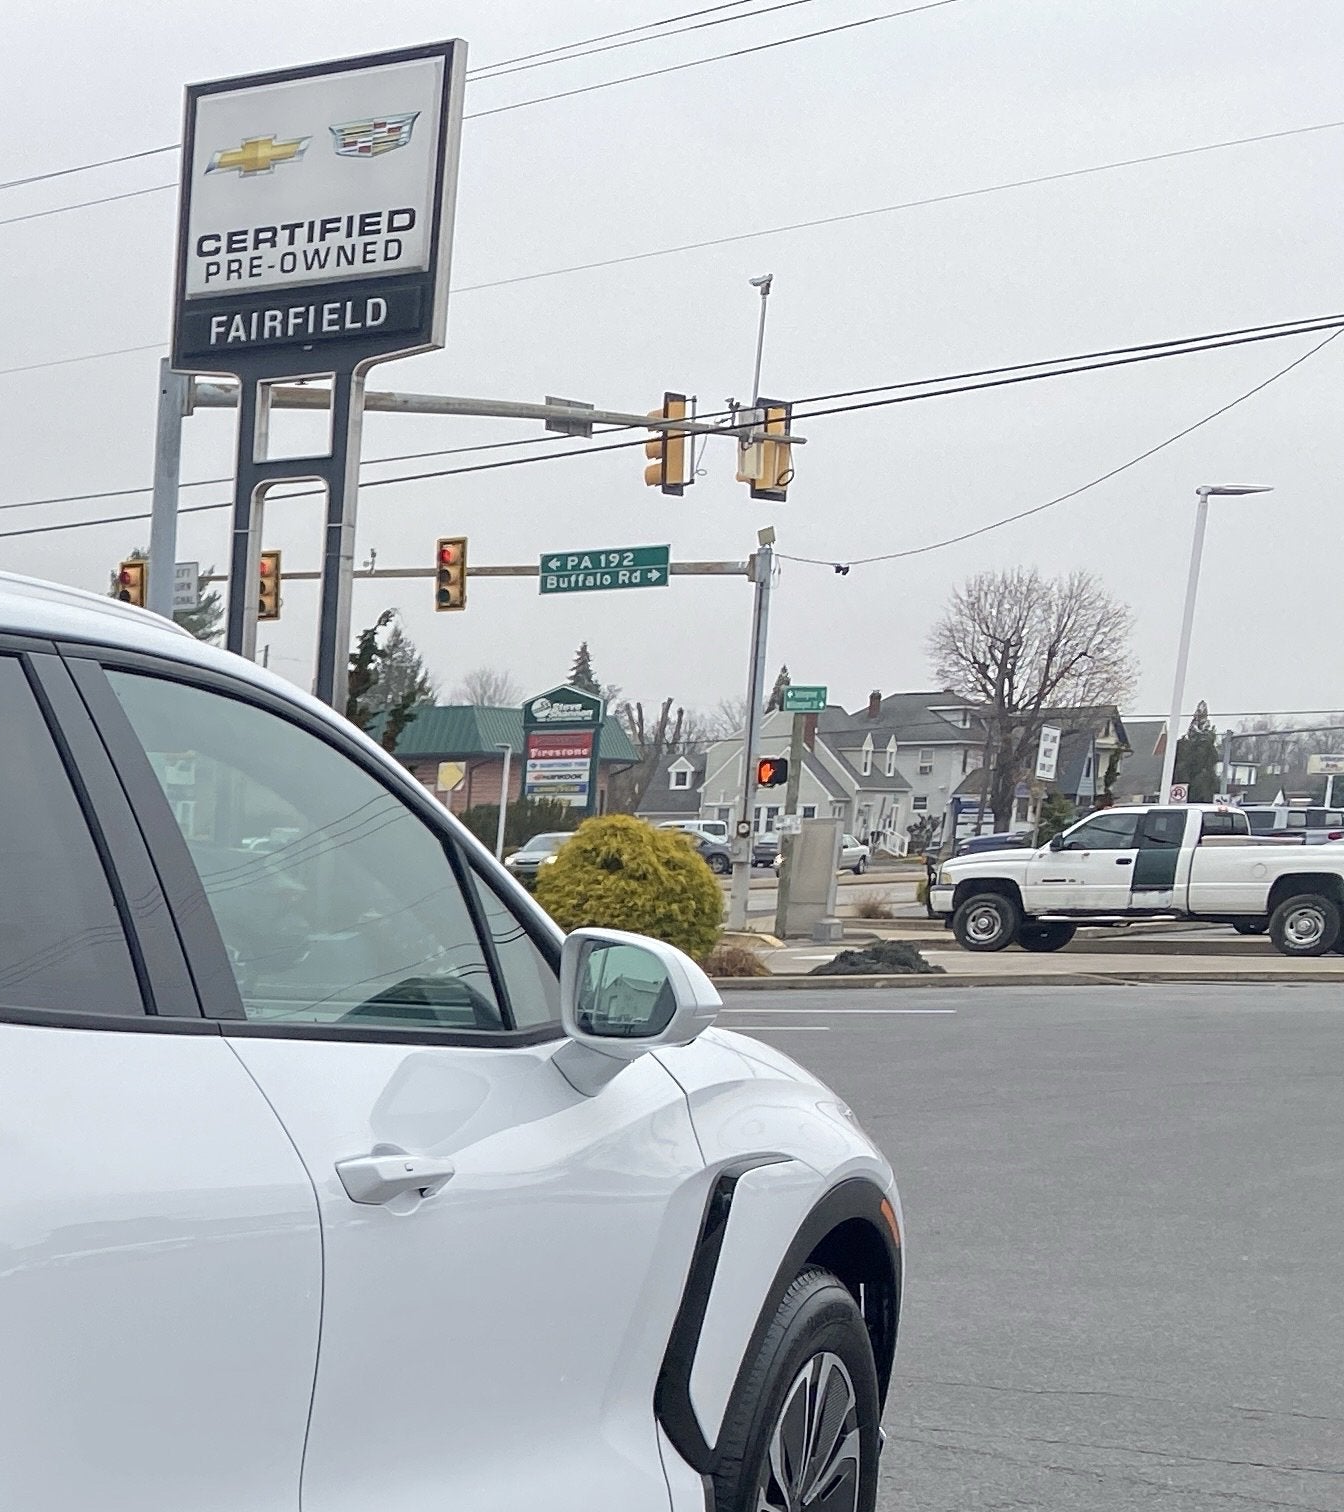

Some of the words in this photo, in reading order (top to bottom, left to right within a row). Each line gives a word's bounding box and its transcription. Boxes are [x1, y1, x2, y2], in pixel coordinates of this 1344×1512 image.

[196, 207, 416, 258] CERTIFIED
[205, 238, 402, 284] PRE-OWNED
[209, 297, 388, 345] FAIRFIELD
[567, 555, 593, 570] PA
[599, 552, 634, 567] 192
[546, 572, 612, 589] Buffalo
[618, 570, 641, 584] Rd
[530, 748, 589, 758] Firestone
